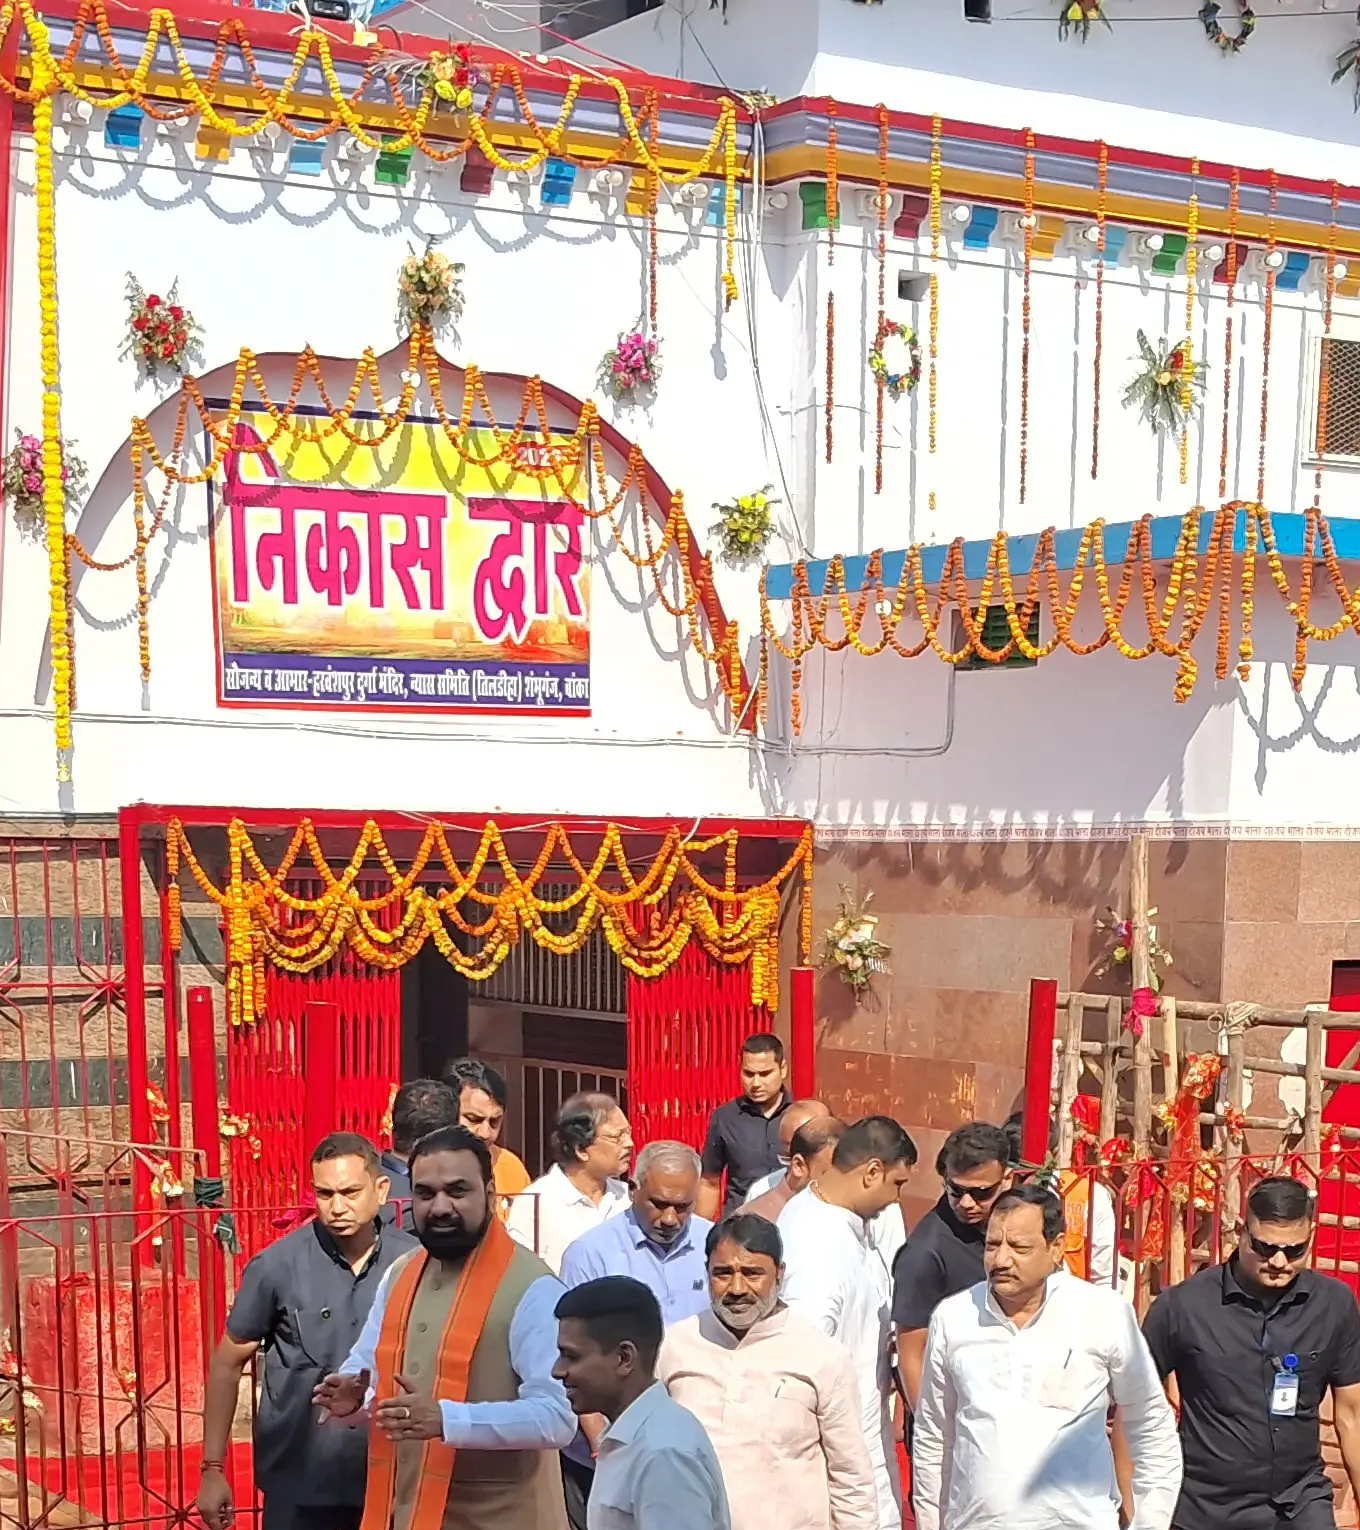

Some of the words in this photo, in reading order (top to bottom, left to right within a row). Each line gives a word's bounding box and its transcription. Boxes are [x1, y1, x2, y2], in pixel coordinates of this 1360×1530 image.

[223, 422, 447, 610] निकास
[468, 497, 584, 639] द्वार
[225, 661, 262, 691] सौजन्य
[264, 669, 273, 692] व
